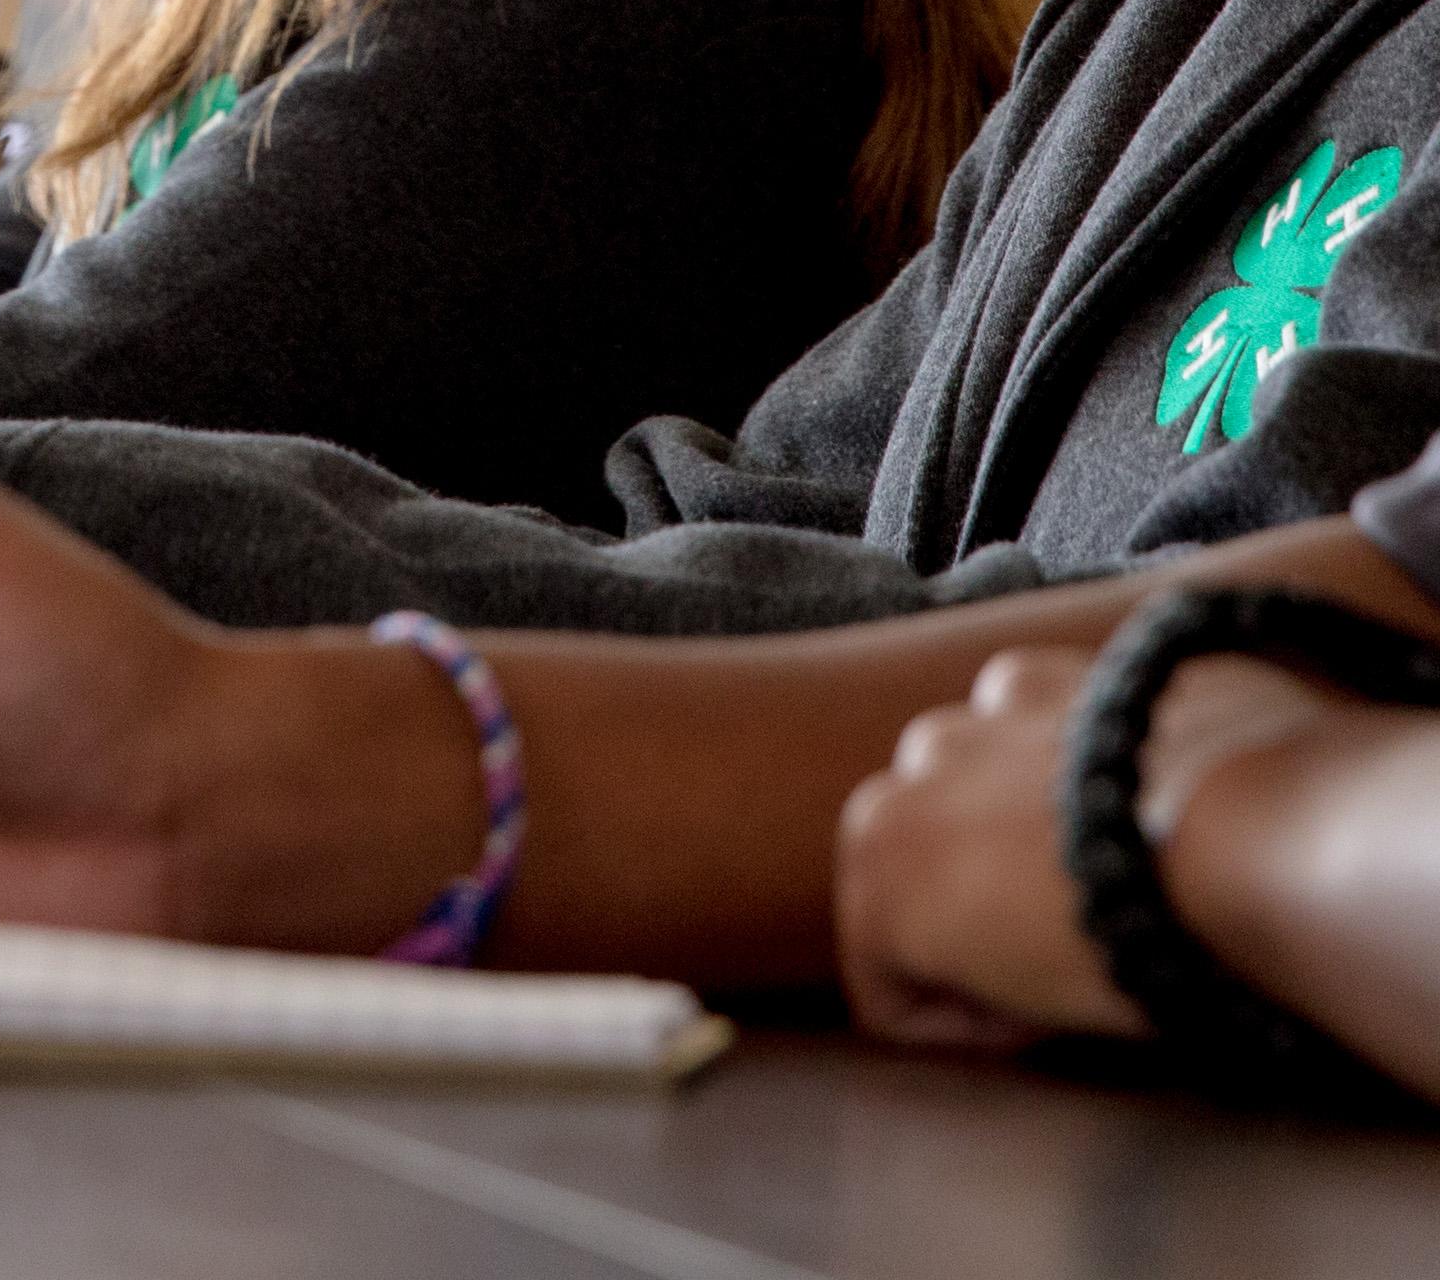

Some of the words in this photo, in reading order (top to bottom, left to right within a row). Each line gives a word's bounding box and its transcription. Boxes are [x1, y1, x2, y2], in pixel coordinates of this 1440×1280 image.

[1261, 179, 1301, 248] H
[1324, 186, 1380, 252] H
[1182, 308, 1228, 381] H
